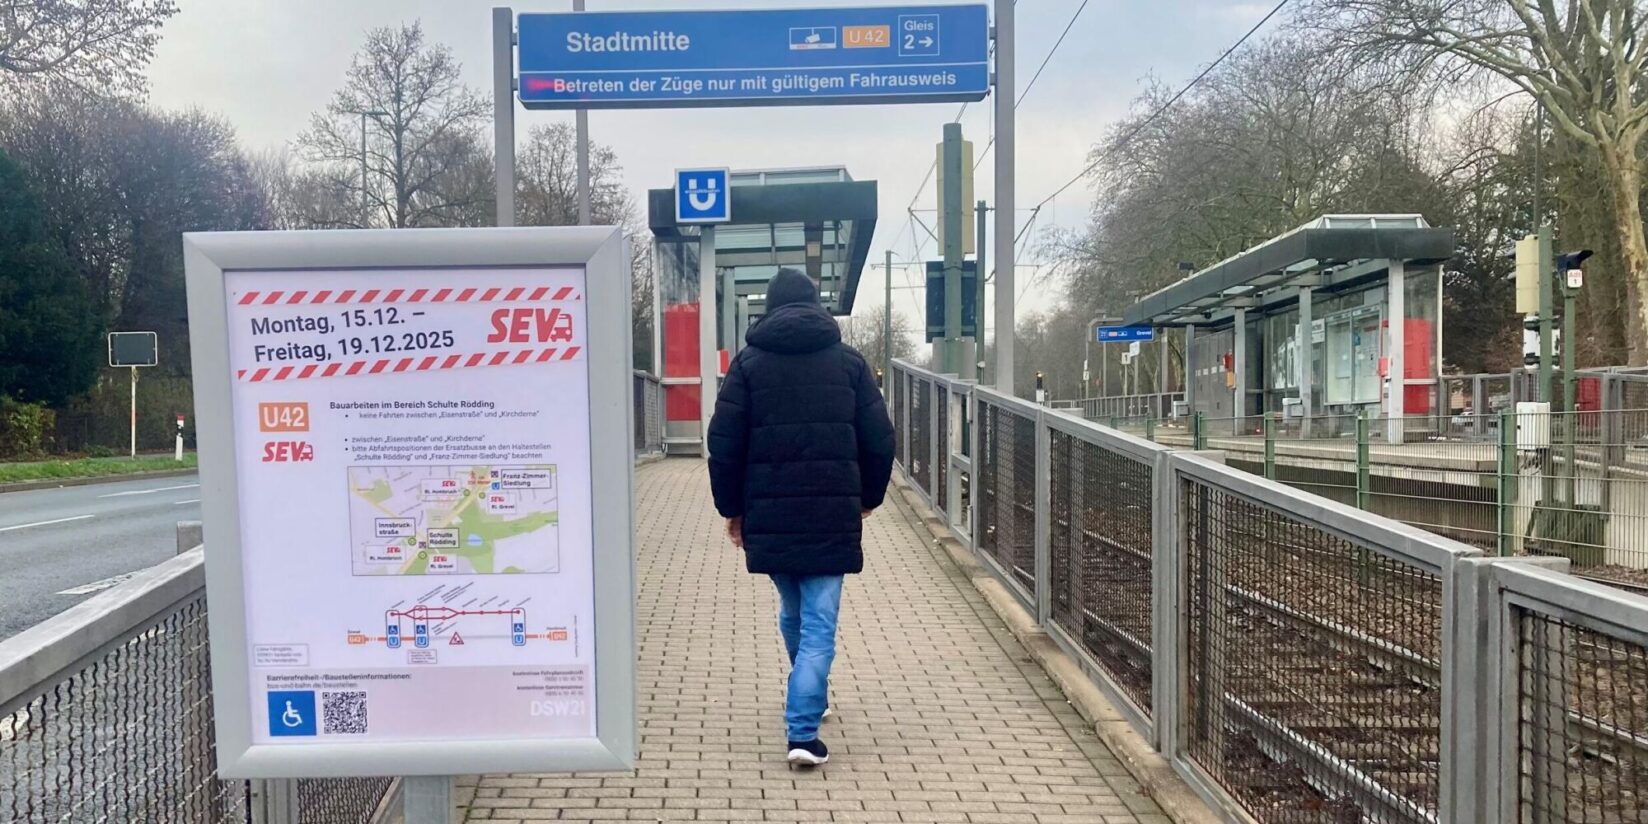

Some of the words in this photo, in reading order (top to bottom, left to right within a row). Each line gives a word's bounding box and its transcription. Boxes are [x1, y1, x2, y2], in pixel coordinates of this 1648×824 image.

[849, 30, 861, 43] U
[864, 29, 884, 43] 42
[904, 20, 934, 31] Gleis
[566, 31, 690, 53] Stadtmitte
[904, 34, 915, 49] 2
[553, 77, 625, 94] Betreten
[629, 75, 656, 92] der
[661, 74, 703, 95] Züge
[708, 77, 735, 92] nur
[740, 73, 767, 90] mit
[771, 72, 845, 93] gültigem
[850, 70, 957, 88] Fahrausweis
[688, 178, 717, 211] U
[251, 312, 336, 336] Montag,
[340, 307, 406, 329] 15.12.
[488, 307, 561, 344] SEV
[254, 341, 332, 363] Freitag,
[339, 330, 455, 357] 19.12.2025
[329, 401, 380, 409] Bauarbeiten
[381, 401, 392, 409] im
[394, 400, 426, 409] Bereich
[427, 400, 459, 408] Schulte
[460, 400, 495, 410] Rödding
[406, 411, 437, 419] zwischen
[263, 407, 305, 428] U42
[262, 441, 304, 462] SEV
[368, 445, 432, 453] Abfahrtspositionen
